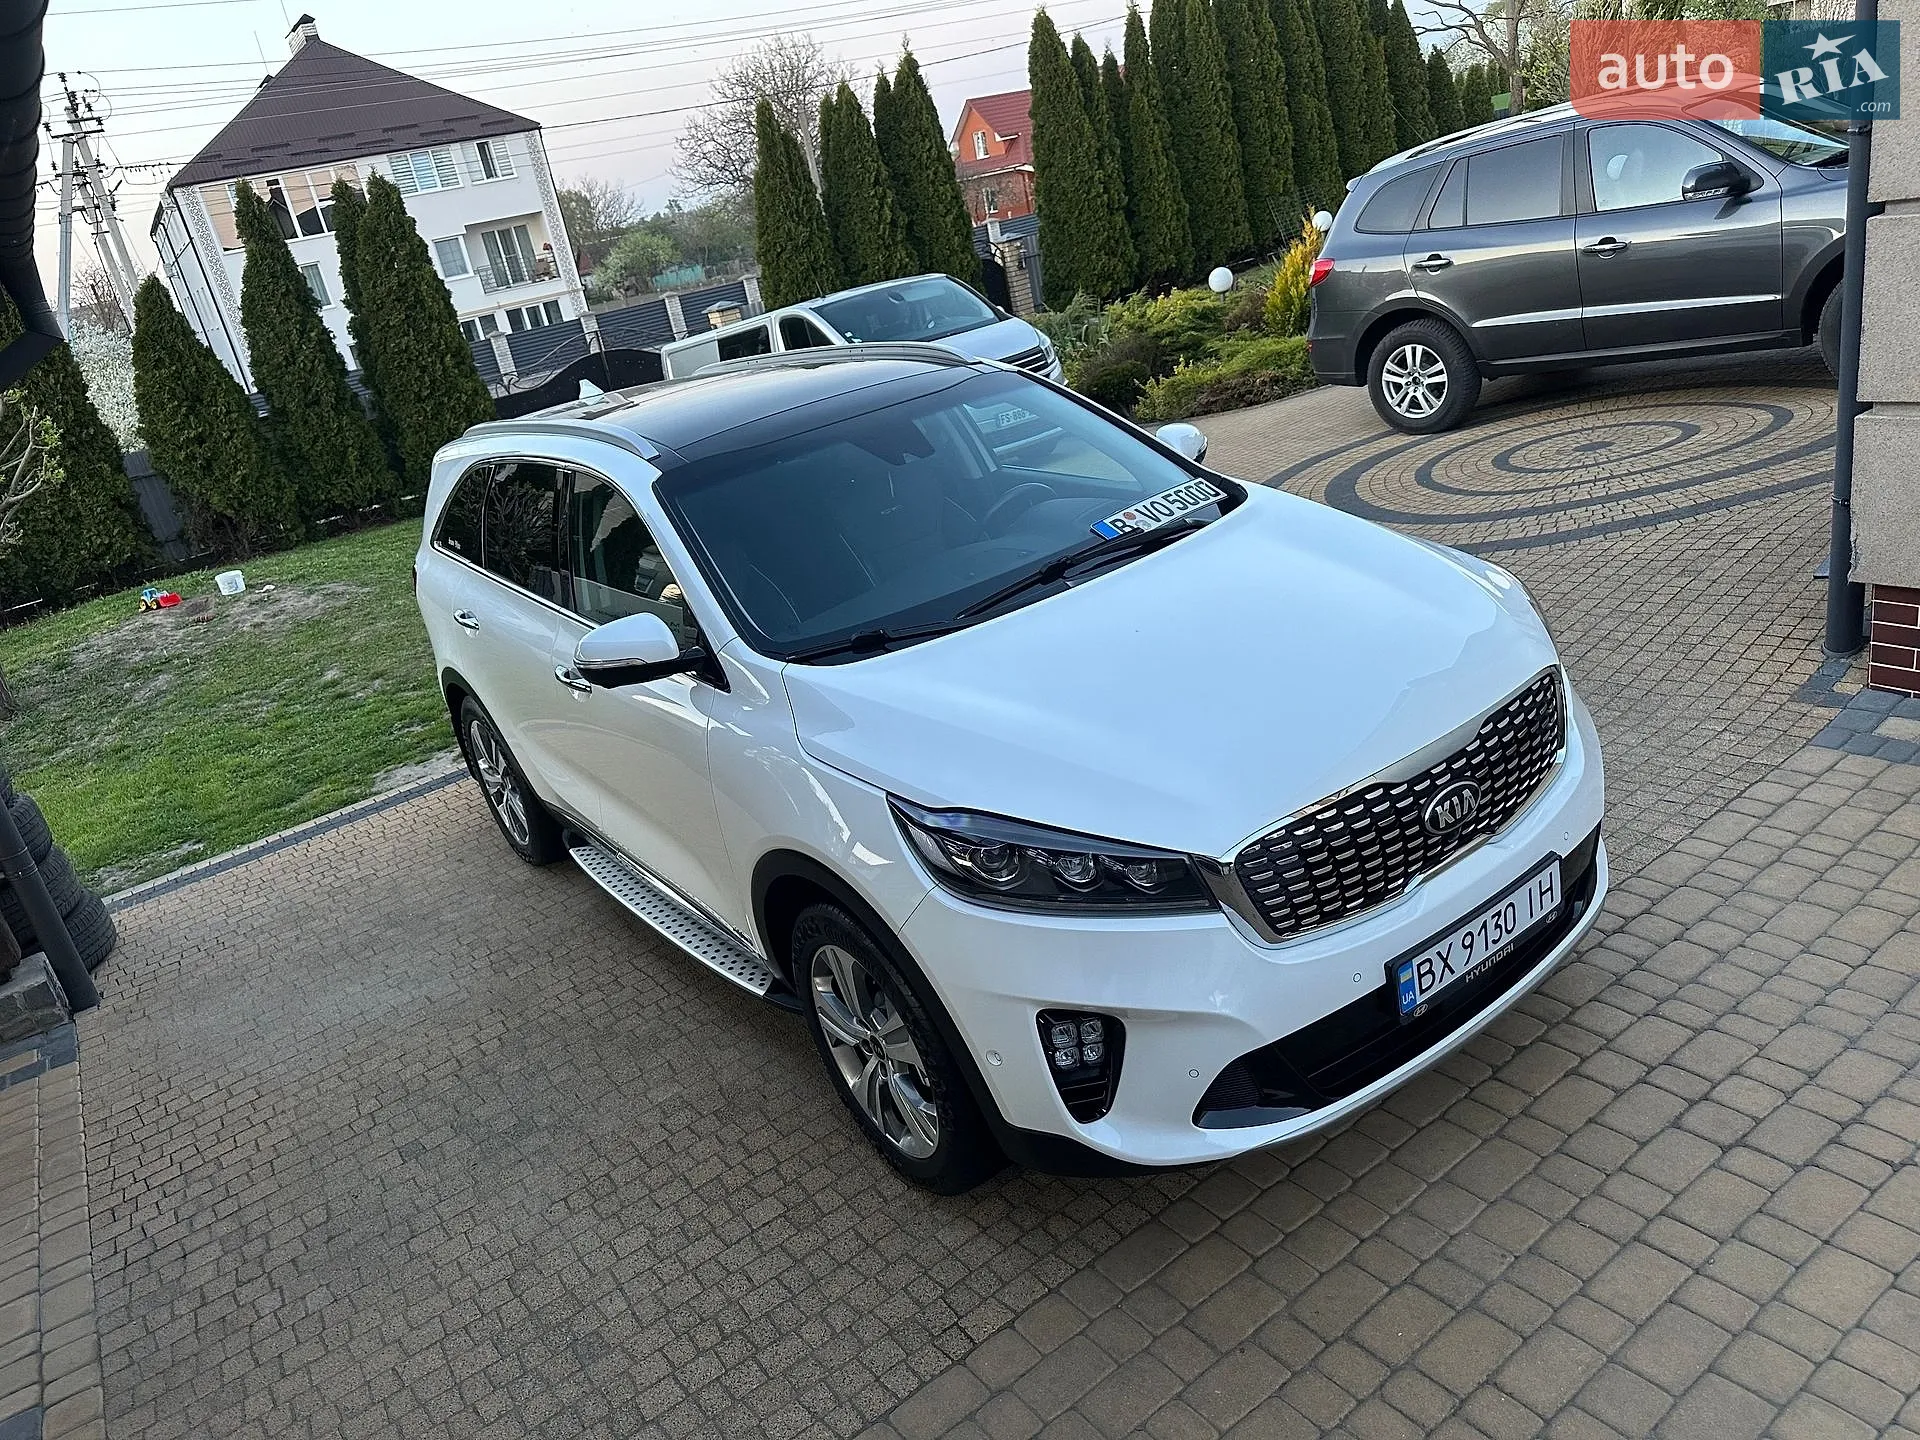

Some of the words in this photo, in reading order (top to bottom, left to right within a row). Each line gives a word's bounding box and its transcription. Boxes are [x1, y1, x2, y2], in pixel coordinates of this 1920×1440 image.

[1435, 788, 1476, 829] KIA
[1416, 941, 1455, 996] BX
[1461, 901, 1516, 967] 9130
[1528, 871, 1554, 919] IH
[1465, 942, 1514, 983] HYUNDAI
[1402, 992, 1415, 1005] UA
